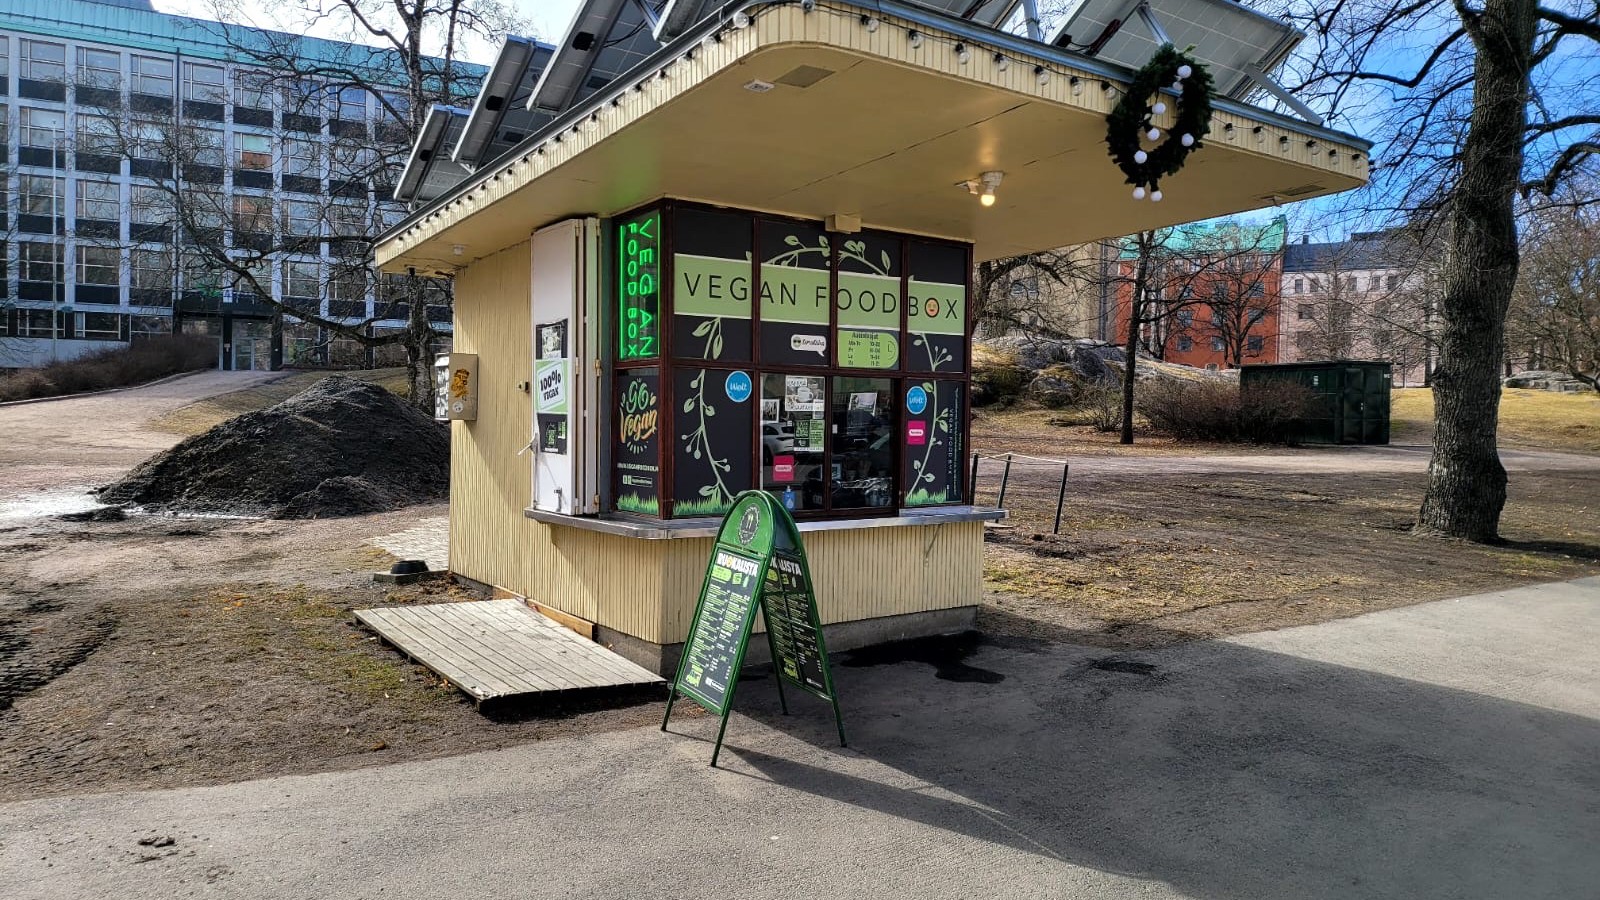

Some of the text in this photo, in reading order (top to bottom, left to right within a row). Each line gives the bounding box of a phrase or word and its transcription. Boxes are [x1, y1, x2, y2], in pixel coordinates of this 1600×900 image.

[627, 222, 638, 356] FOOD BOX
[639, 218, 653, 356] VEGAN
[683, 272, 797, 306] VEGAN
[540, 369, 562, 392] 100%
[729, 382, 748, 391] Wolt
[619, 405, 658, 444] Vegan
